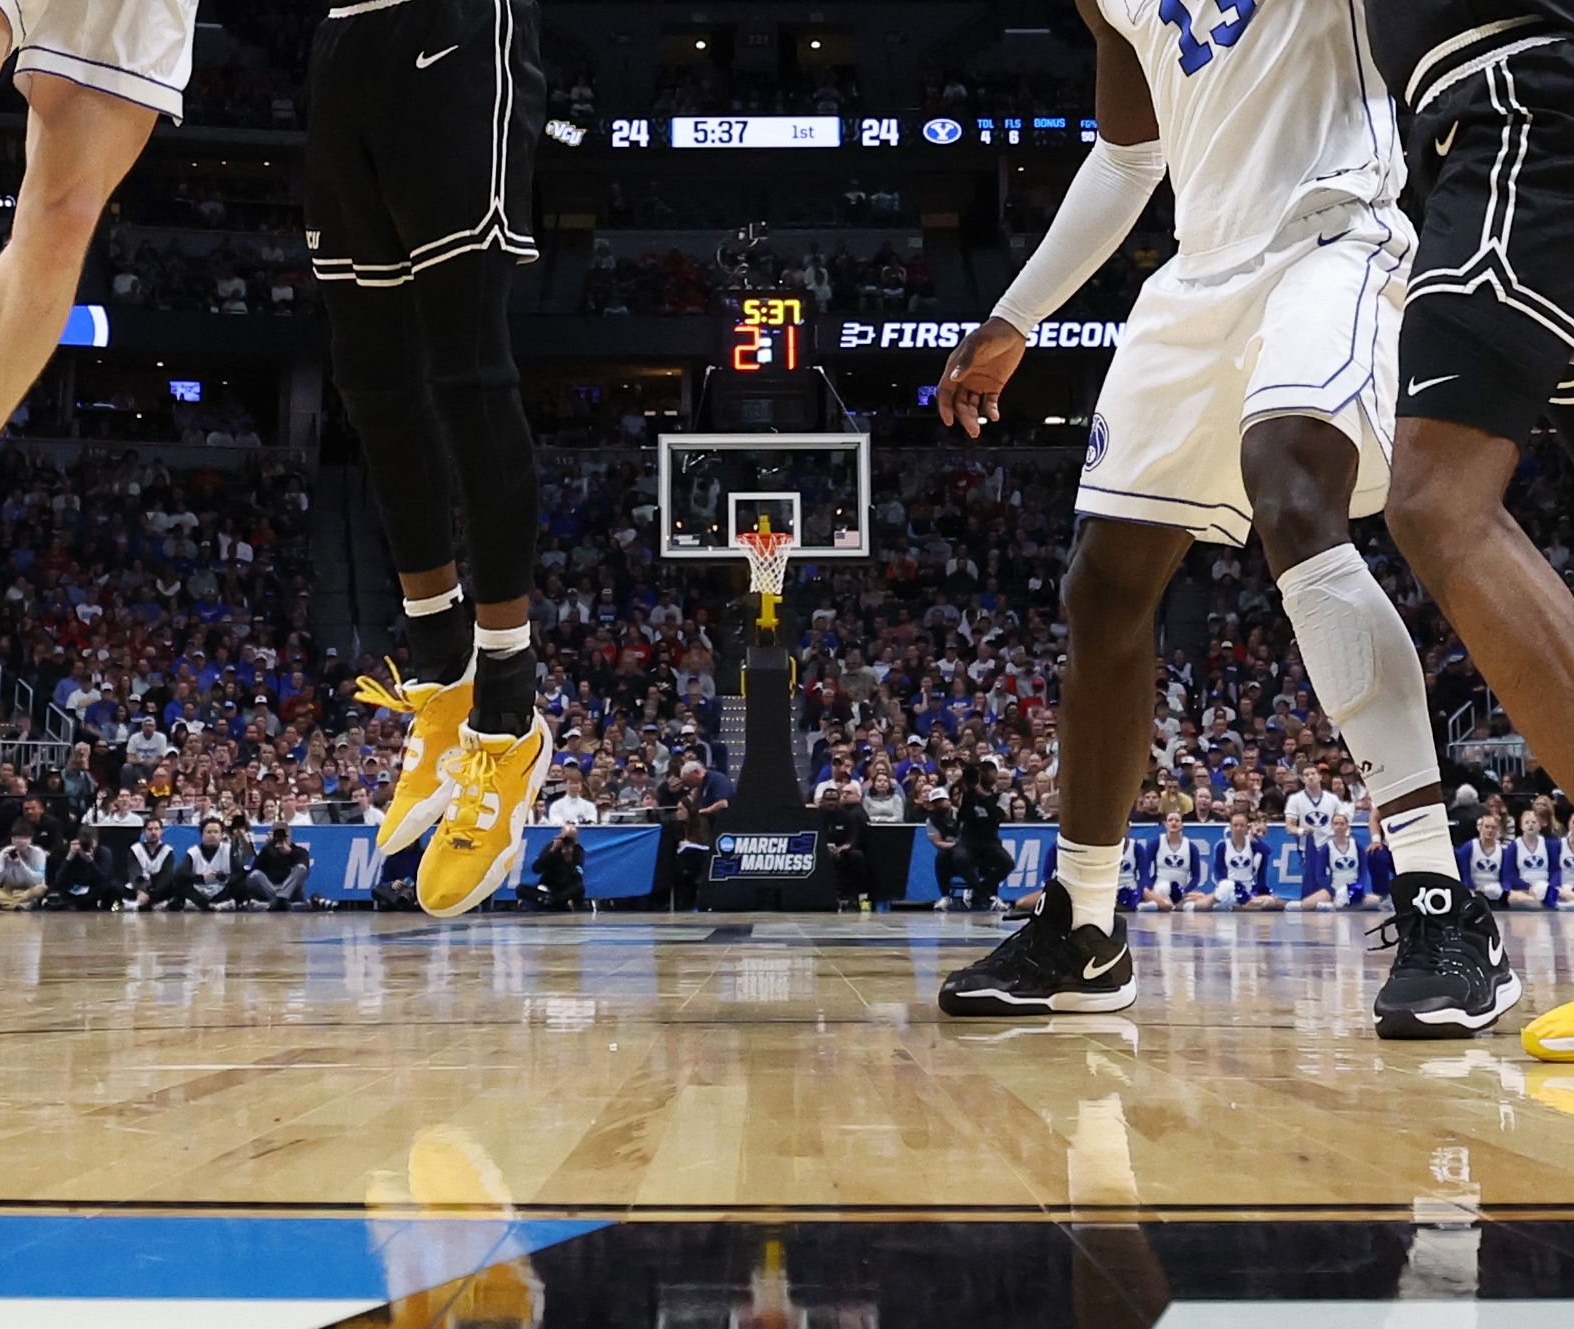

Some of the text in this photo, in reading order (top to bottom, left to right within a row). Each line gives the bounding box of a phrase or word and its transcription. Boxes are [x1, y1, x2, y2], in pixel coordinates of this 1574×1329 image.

[612, 119, 650, 148] 24
[693, 120, 749, 145] 5:37
[791, 122, 815, 140] 1st
[861, 118, 900, 147] 24
[743, 299, 801, 325] 5:37
[734, 837, 788, 854] MARCH
[740, 853, 814, 871] MADNESS
